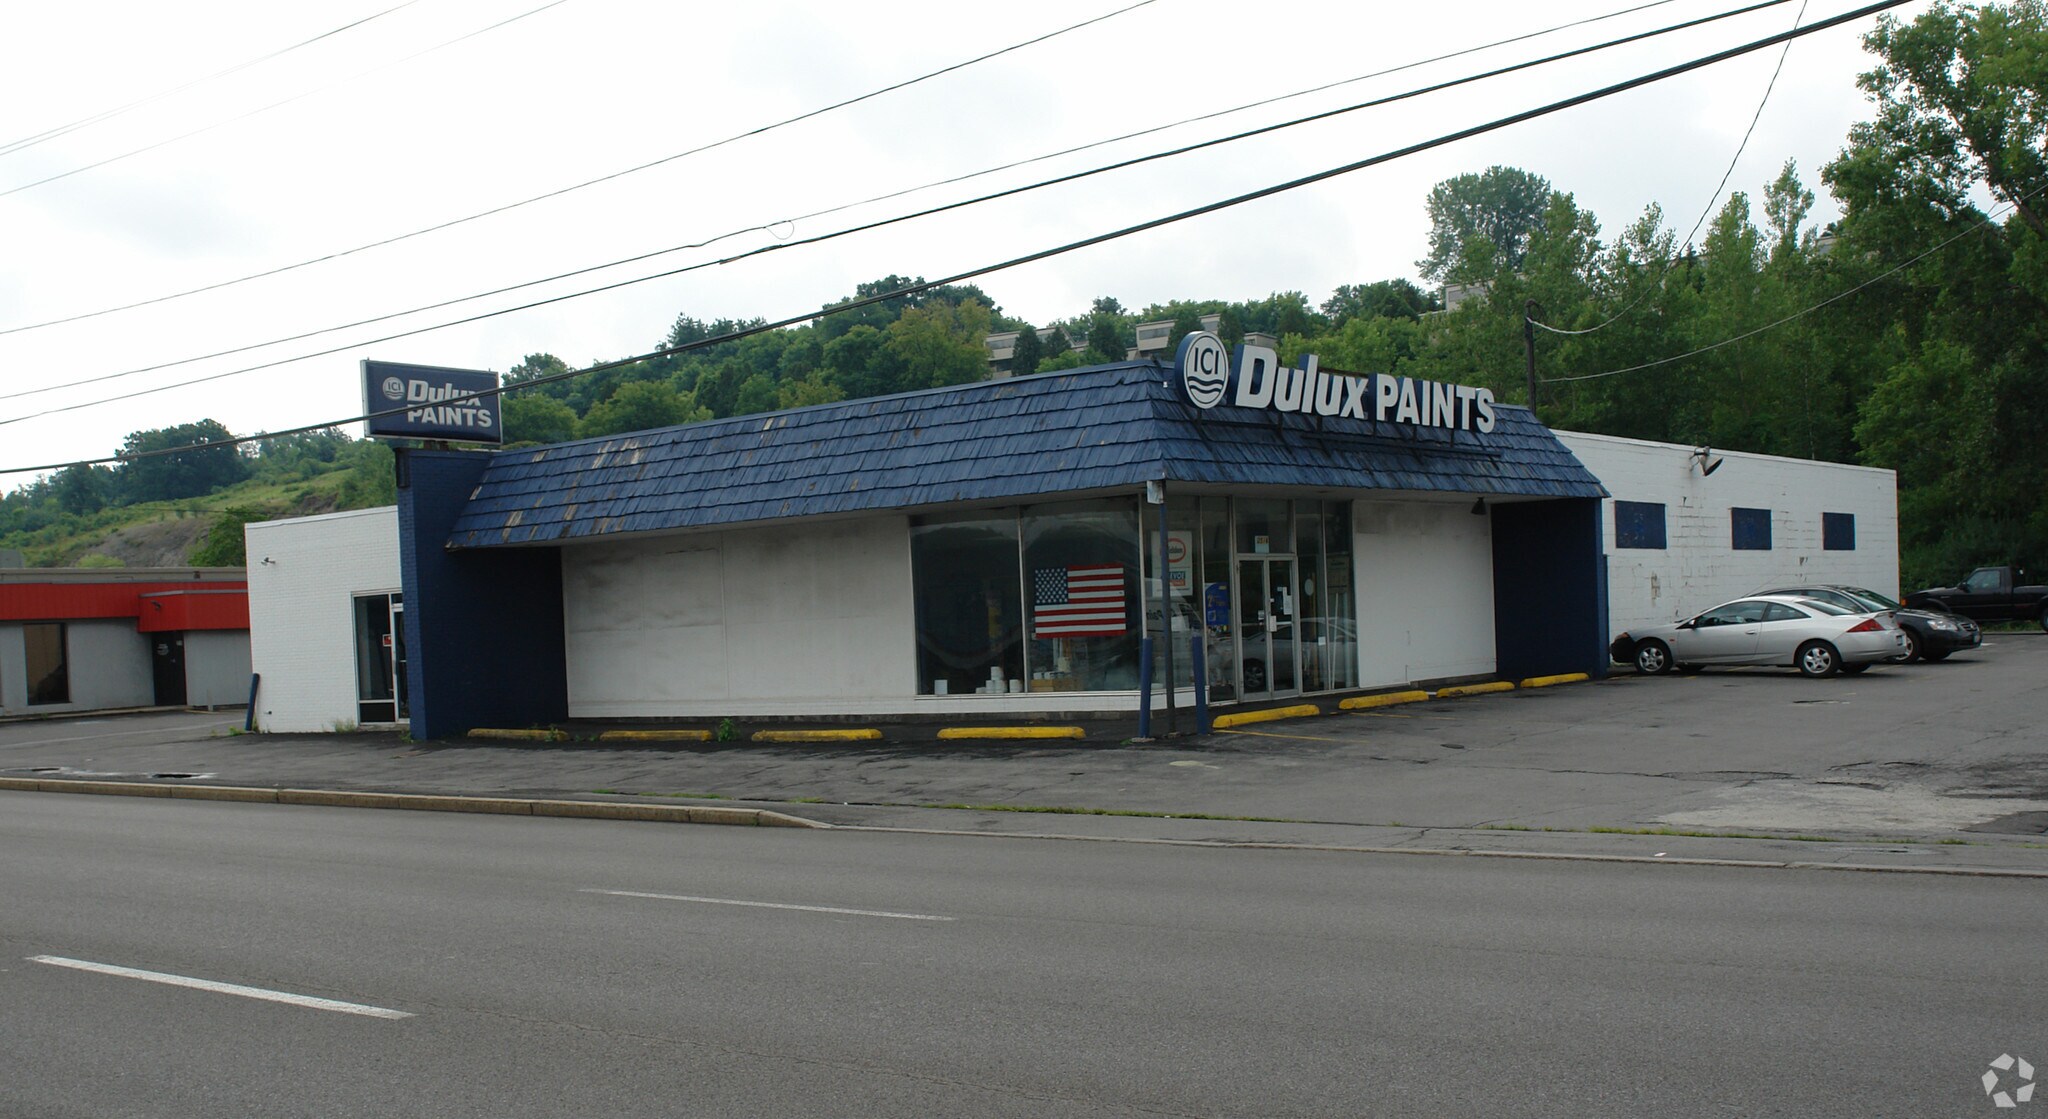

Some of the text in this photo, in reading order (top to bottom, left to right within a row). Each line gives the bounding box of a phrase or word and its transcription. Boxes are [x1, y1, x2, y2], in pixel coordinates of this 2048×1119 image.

[1193, 346, 1220, 376] ICI
[387, 381, 401, 392] ICI
[406, 379, 482, 407] Dulux
[1234, 343, 1496, 434] Dulux PAINTS
[406, 403, 493, 428] PAINTS
